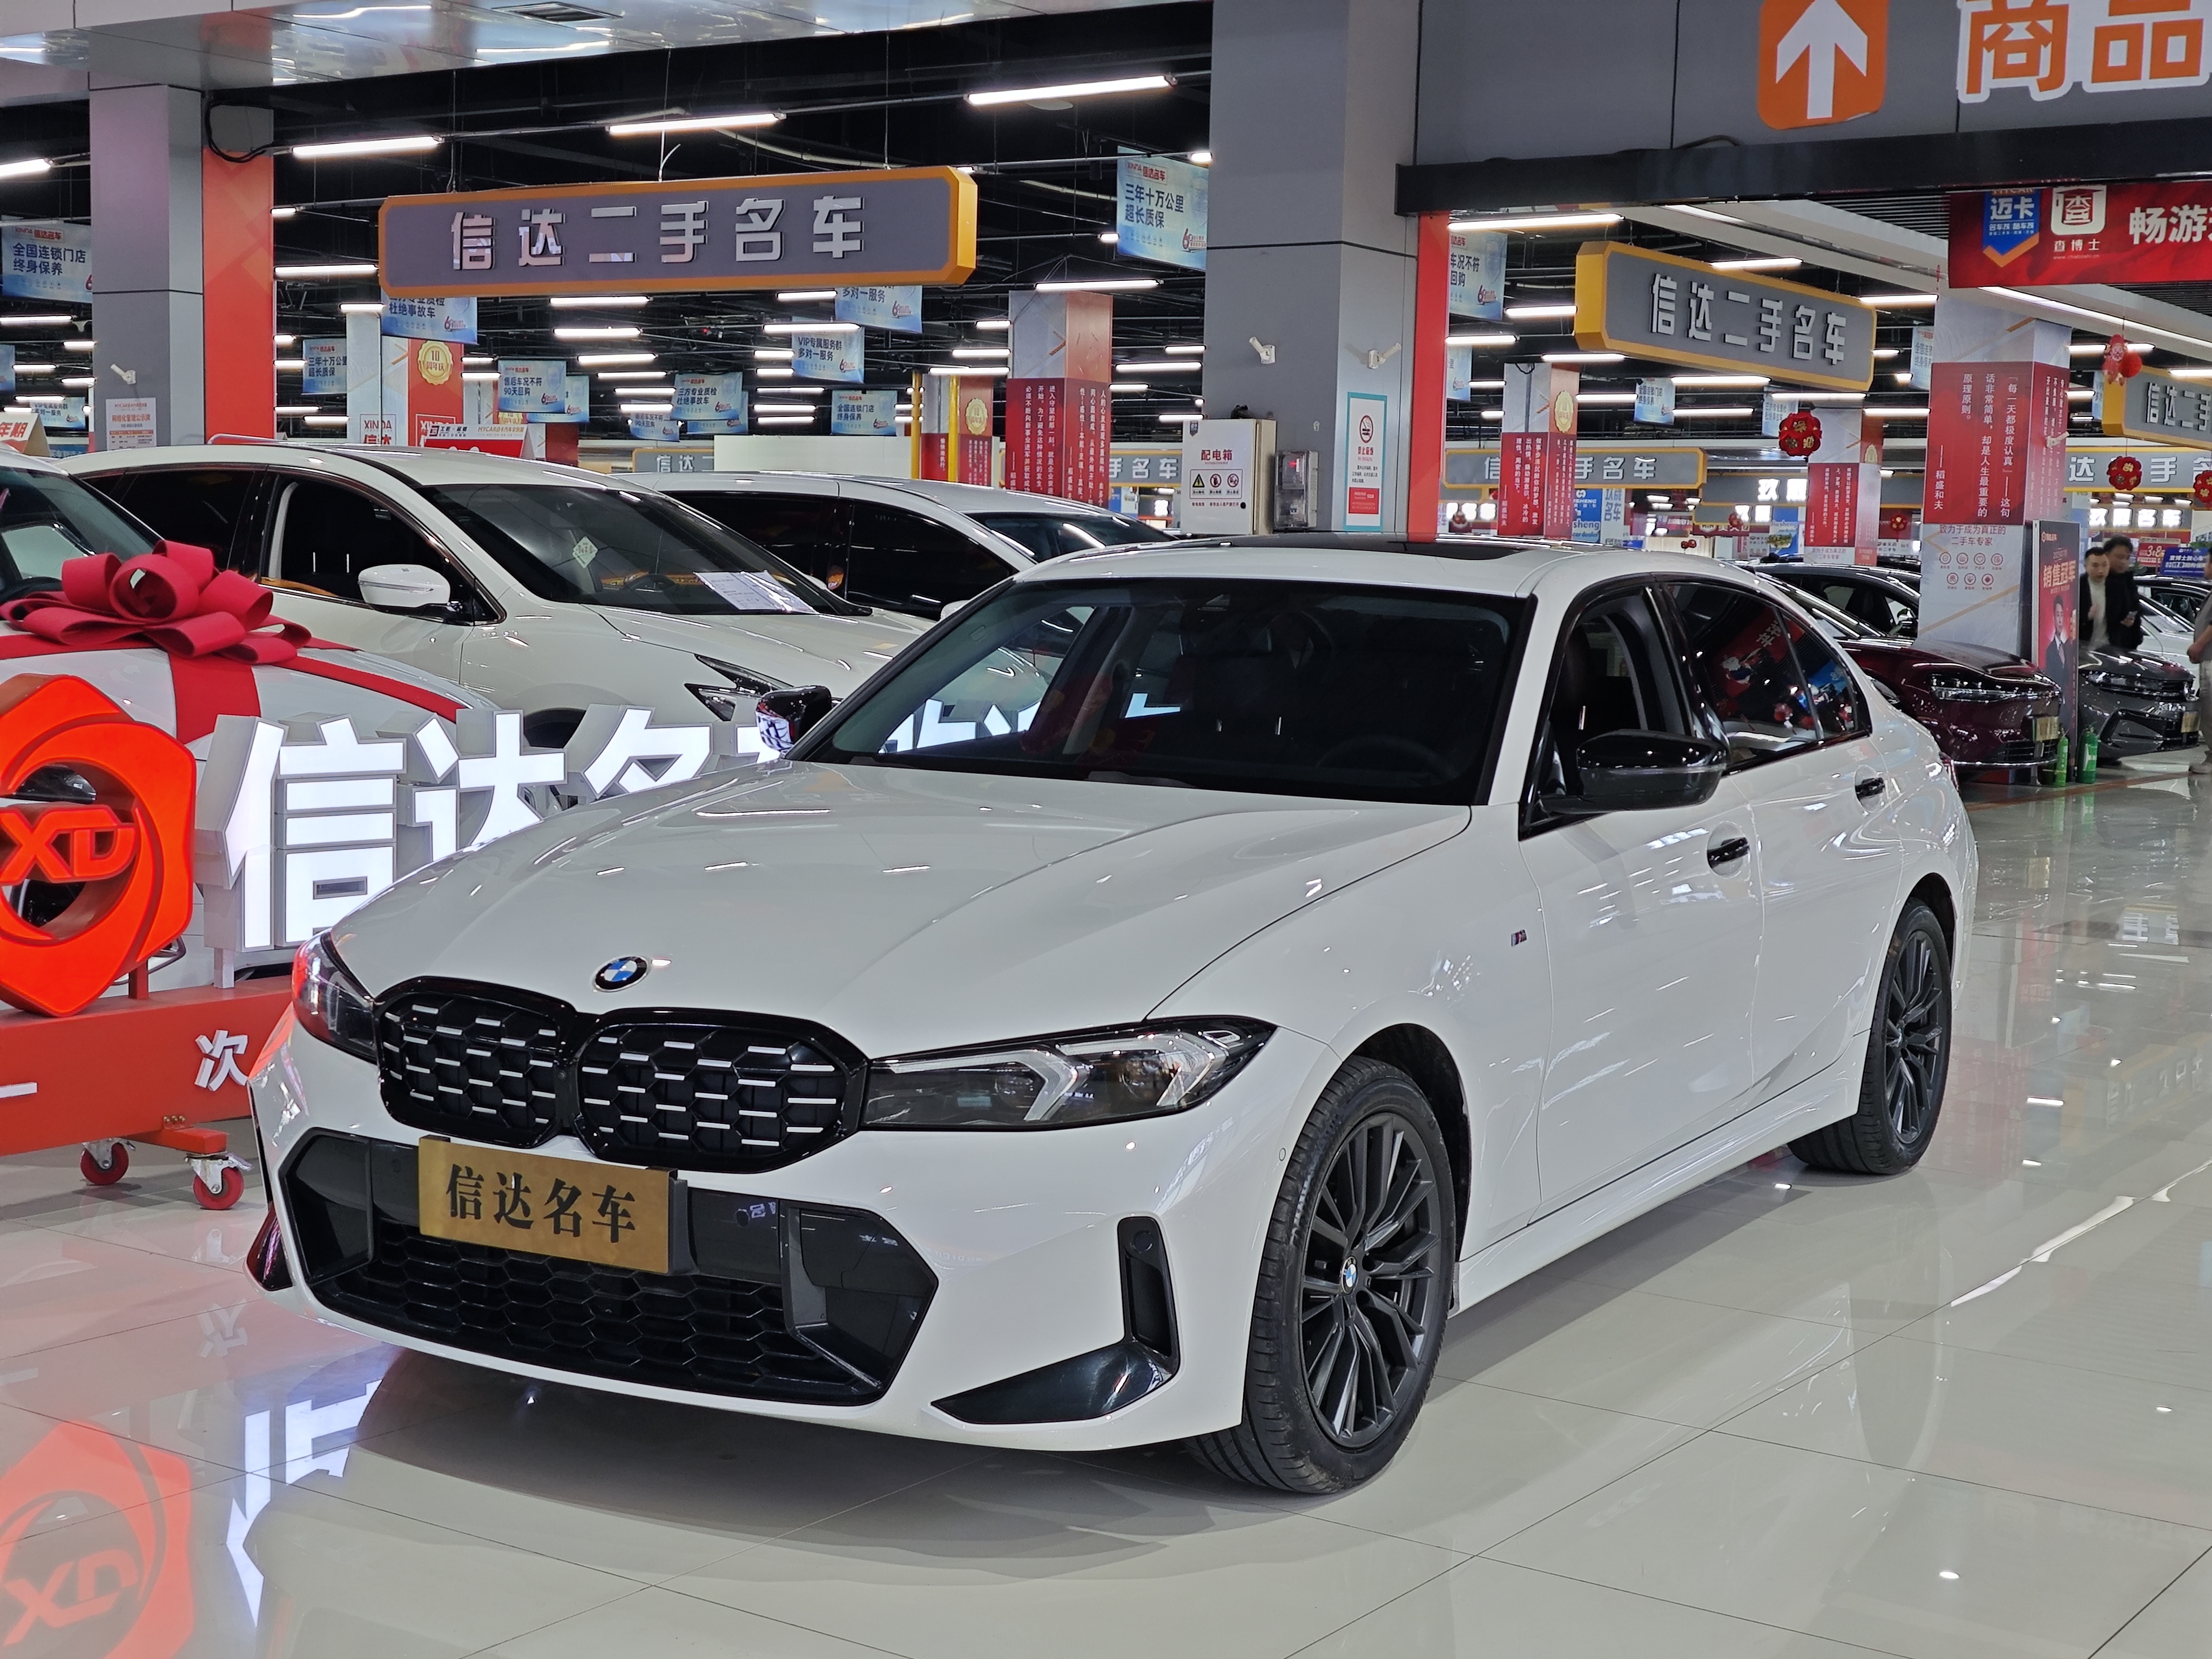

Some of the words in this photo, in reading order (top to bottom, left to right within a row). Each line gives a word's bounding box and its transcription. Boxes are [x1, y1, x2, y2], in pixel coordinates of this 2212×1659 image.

[1143, 166, 1165, 181] 信达名车
[1125, 183, 1184, 213] 三年十万公里
[1125, 204, 1164, 228] 超长质保
[1991, 197, 2035, 220] 迈卡
[451, 195, 864, 270] 信达二手名车
[2129, 204, 2212, 245] 畅游
[13, 242, 86, 263] 全国连锁门店
[2054, 238, 2100, 252] 查博士
[14, 258, 63, 276] 终身保养
[1451, 253, 1480, 272] 车况不符
[1451, 271, 1466, 287] 回购
[842, 287, 886, 303] 多对一服务
[389, 302, 436, 318] 杜绝事故车
[1651, 273, 1847, 365] 信达二手名车
[798, 336, 842, 350] VIP专属服务群
[431, 350, 440, 361] 10
[798, 348, 834, 361] 多对一服务
[308, 367, 335, 377] 超长质保
[504, 377, 542, 386] 售后车况不符
[503, 387, 530, 396] 90天回购
[678, 387, 718, 396] 三方专业质检
[1961, 373, 1973, 420] 原理原则。
[2146, 382, 2211, 431] 信达二手
[1201, 449, 1233, 461] 配电箱
[1109, 457, 1178, 480] 手名车
[1939, 524, 2006, 535] 致力于成为真正的
[1952, 537, 1993, 547] 二手车专家
[2043, 559, 2076, 589] 销售冠军
[225, 709, 781, 949] 信达
[194, 1029, 248, 1092] 次
[446, 1164, 636, 1243] 信达名车
